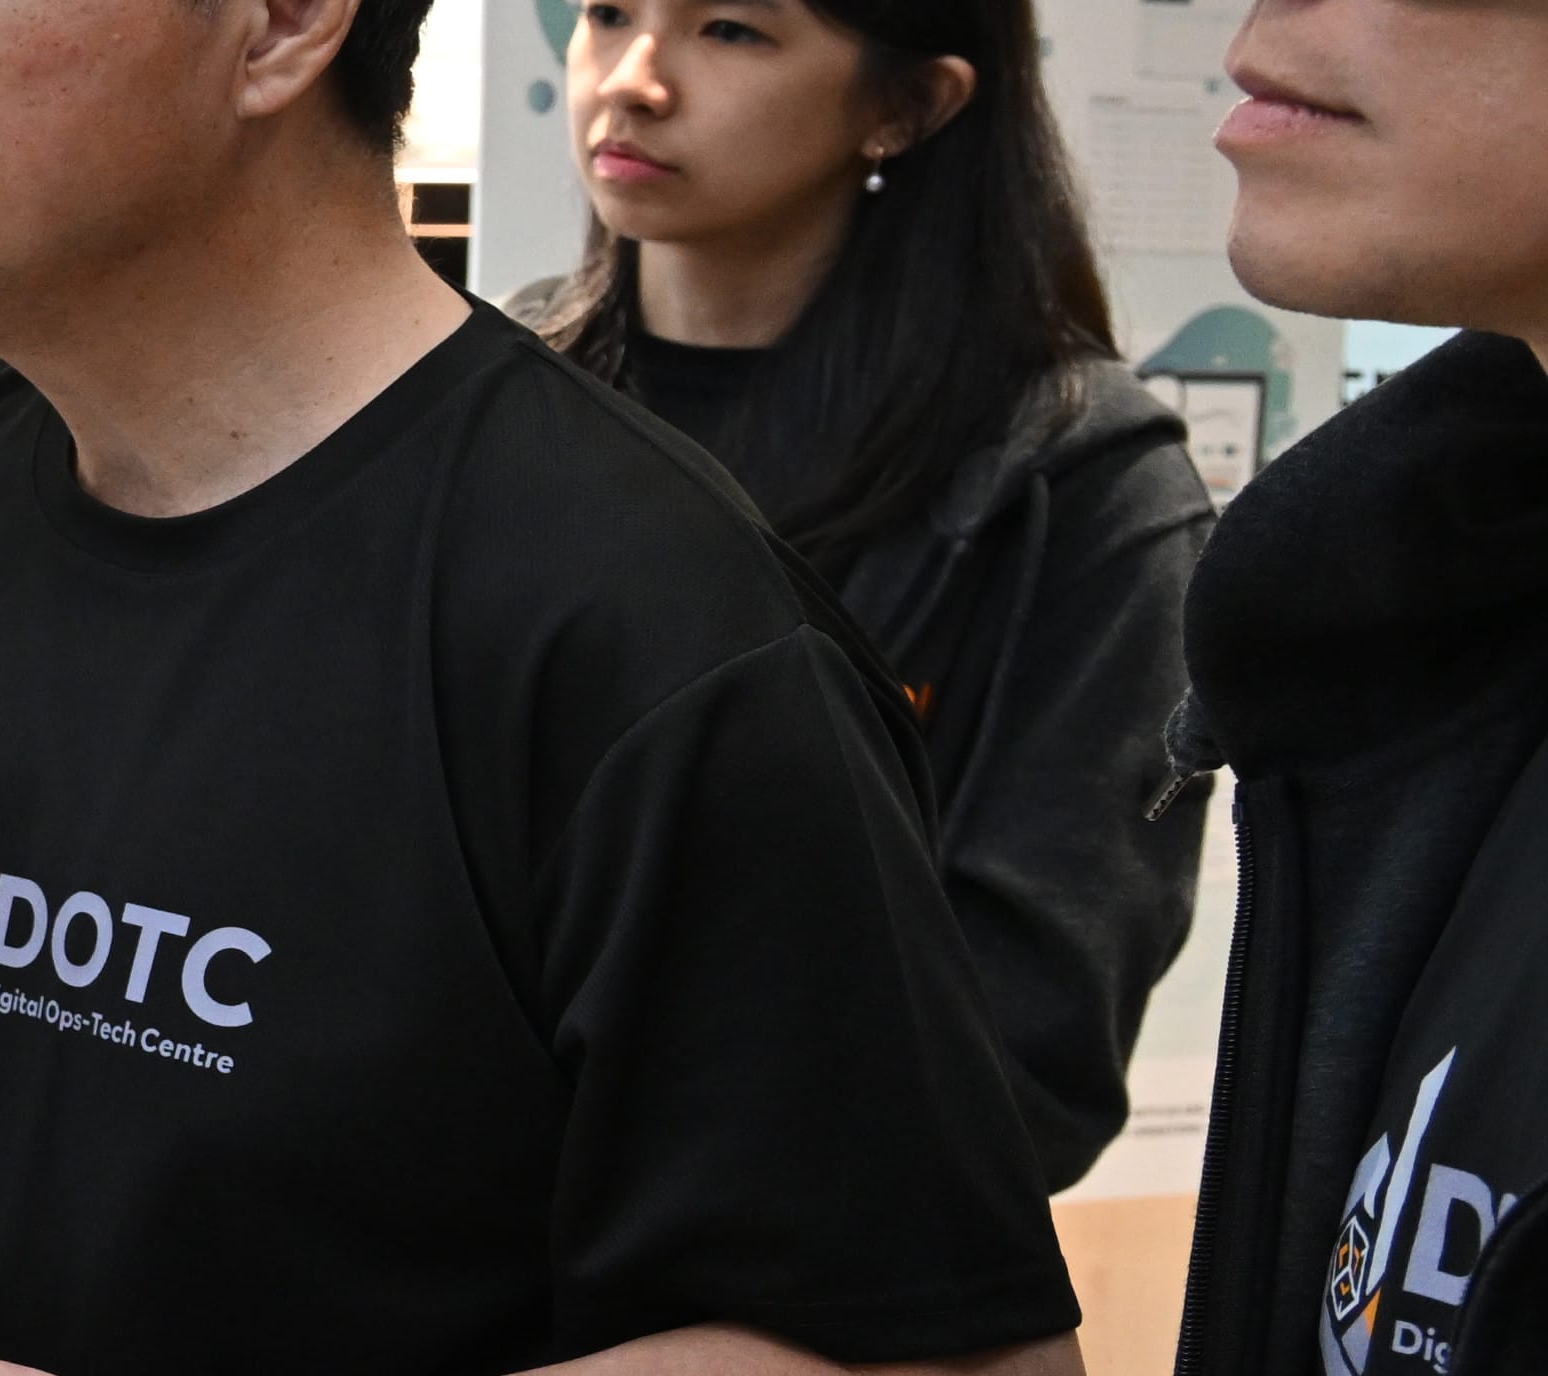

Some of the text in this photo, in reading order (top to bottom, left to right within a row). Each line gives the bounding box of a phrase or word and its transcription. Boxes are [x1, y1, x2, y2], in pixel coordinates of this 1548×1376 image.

[45, 998, 137, 1048] Ops-Tech
[141, 1028, 235, 1075] Centre
[1402, 1162, 1517, 1306] D
